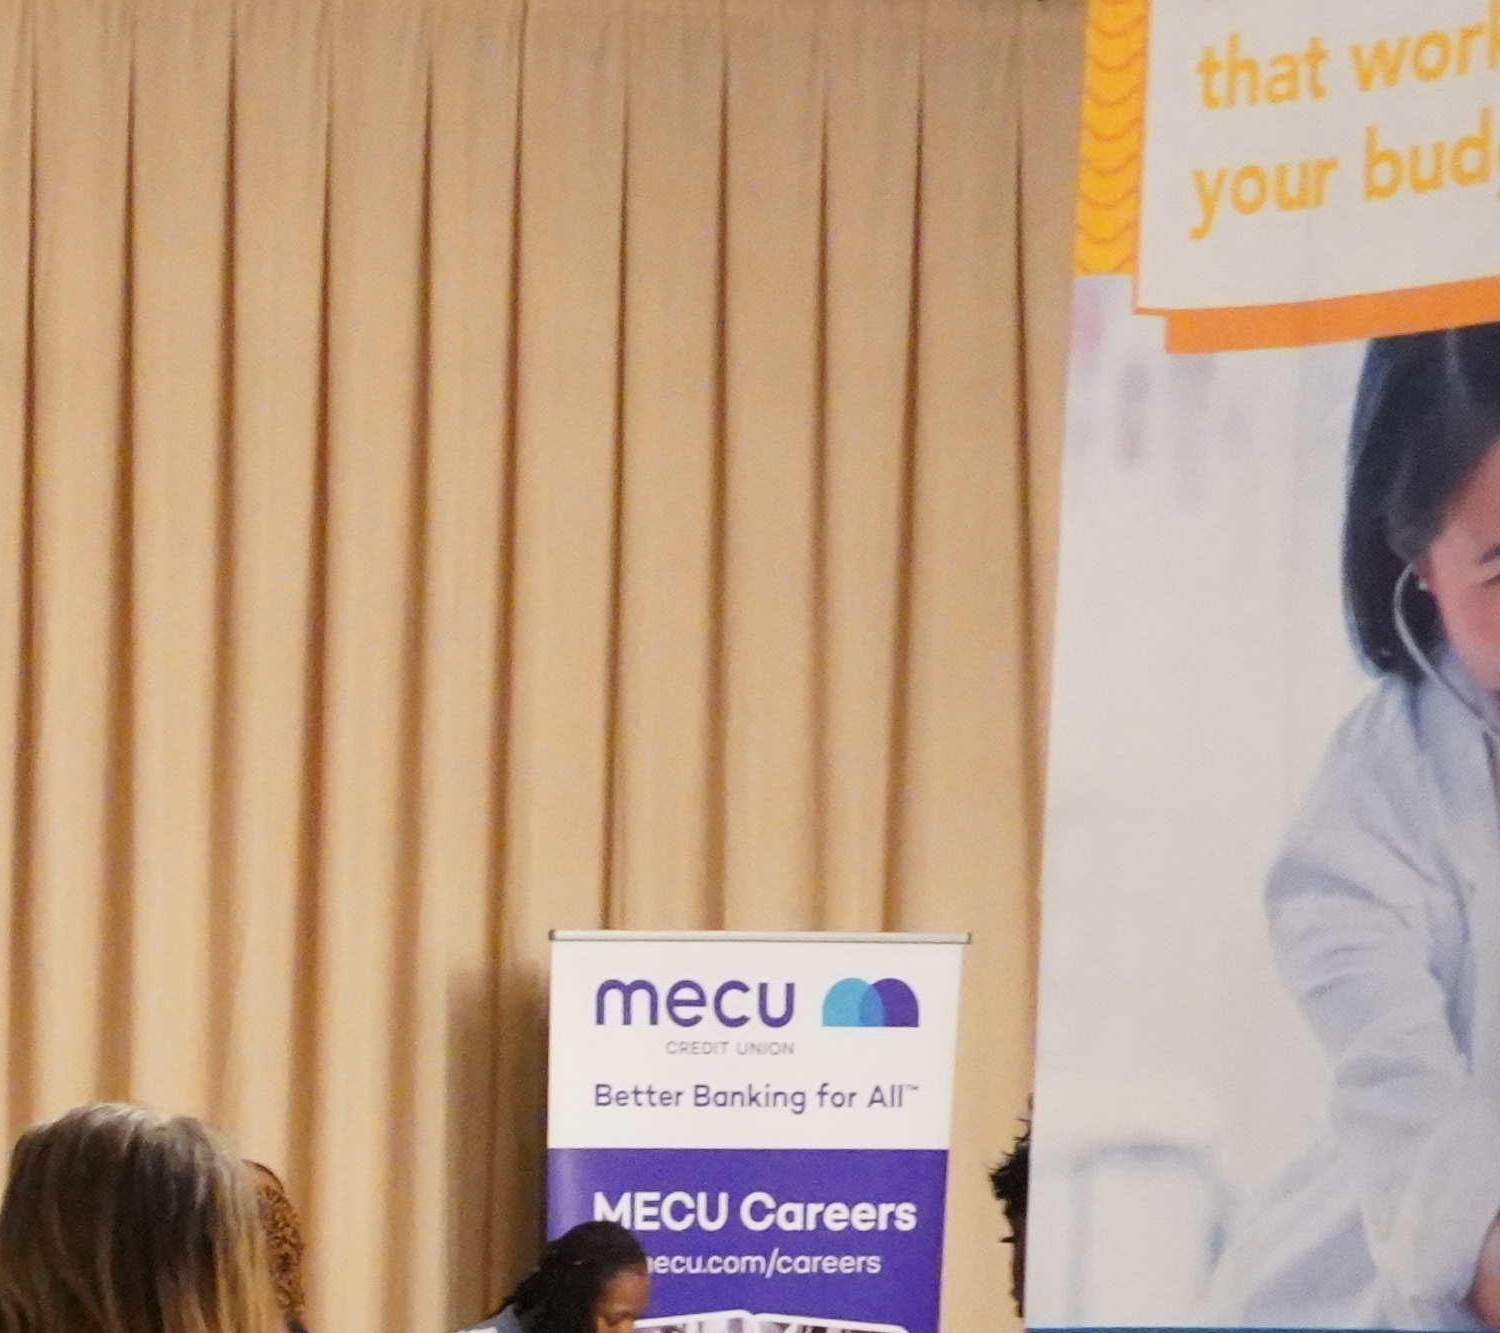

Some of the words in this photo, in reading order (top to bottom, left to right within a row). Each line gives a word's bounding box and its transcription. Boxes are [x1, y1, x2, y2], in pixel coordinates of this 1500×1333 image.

[1196, 31, 1329, 110] that
[1188, 155, 1340, 241] your
[1363, 104, 1500, 202] bud
[596, 979, 796, 1028] mecu
[666, 1041, 730, 1055] CREDIT
[737, 1041, 794, 1055] UNION
[595, 1084, 684, 1107] Better
[694, 1083, 806, 1115] Banking
[817, 1083, 858, 1108] for
[593, 1191, 729, 1231] MECU
[740, 1191, 918, 1232] Careers
